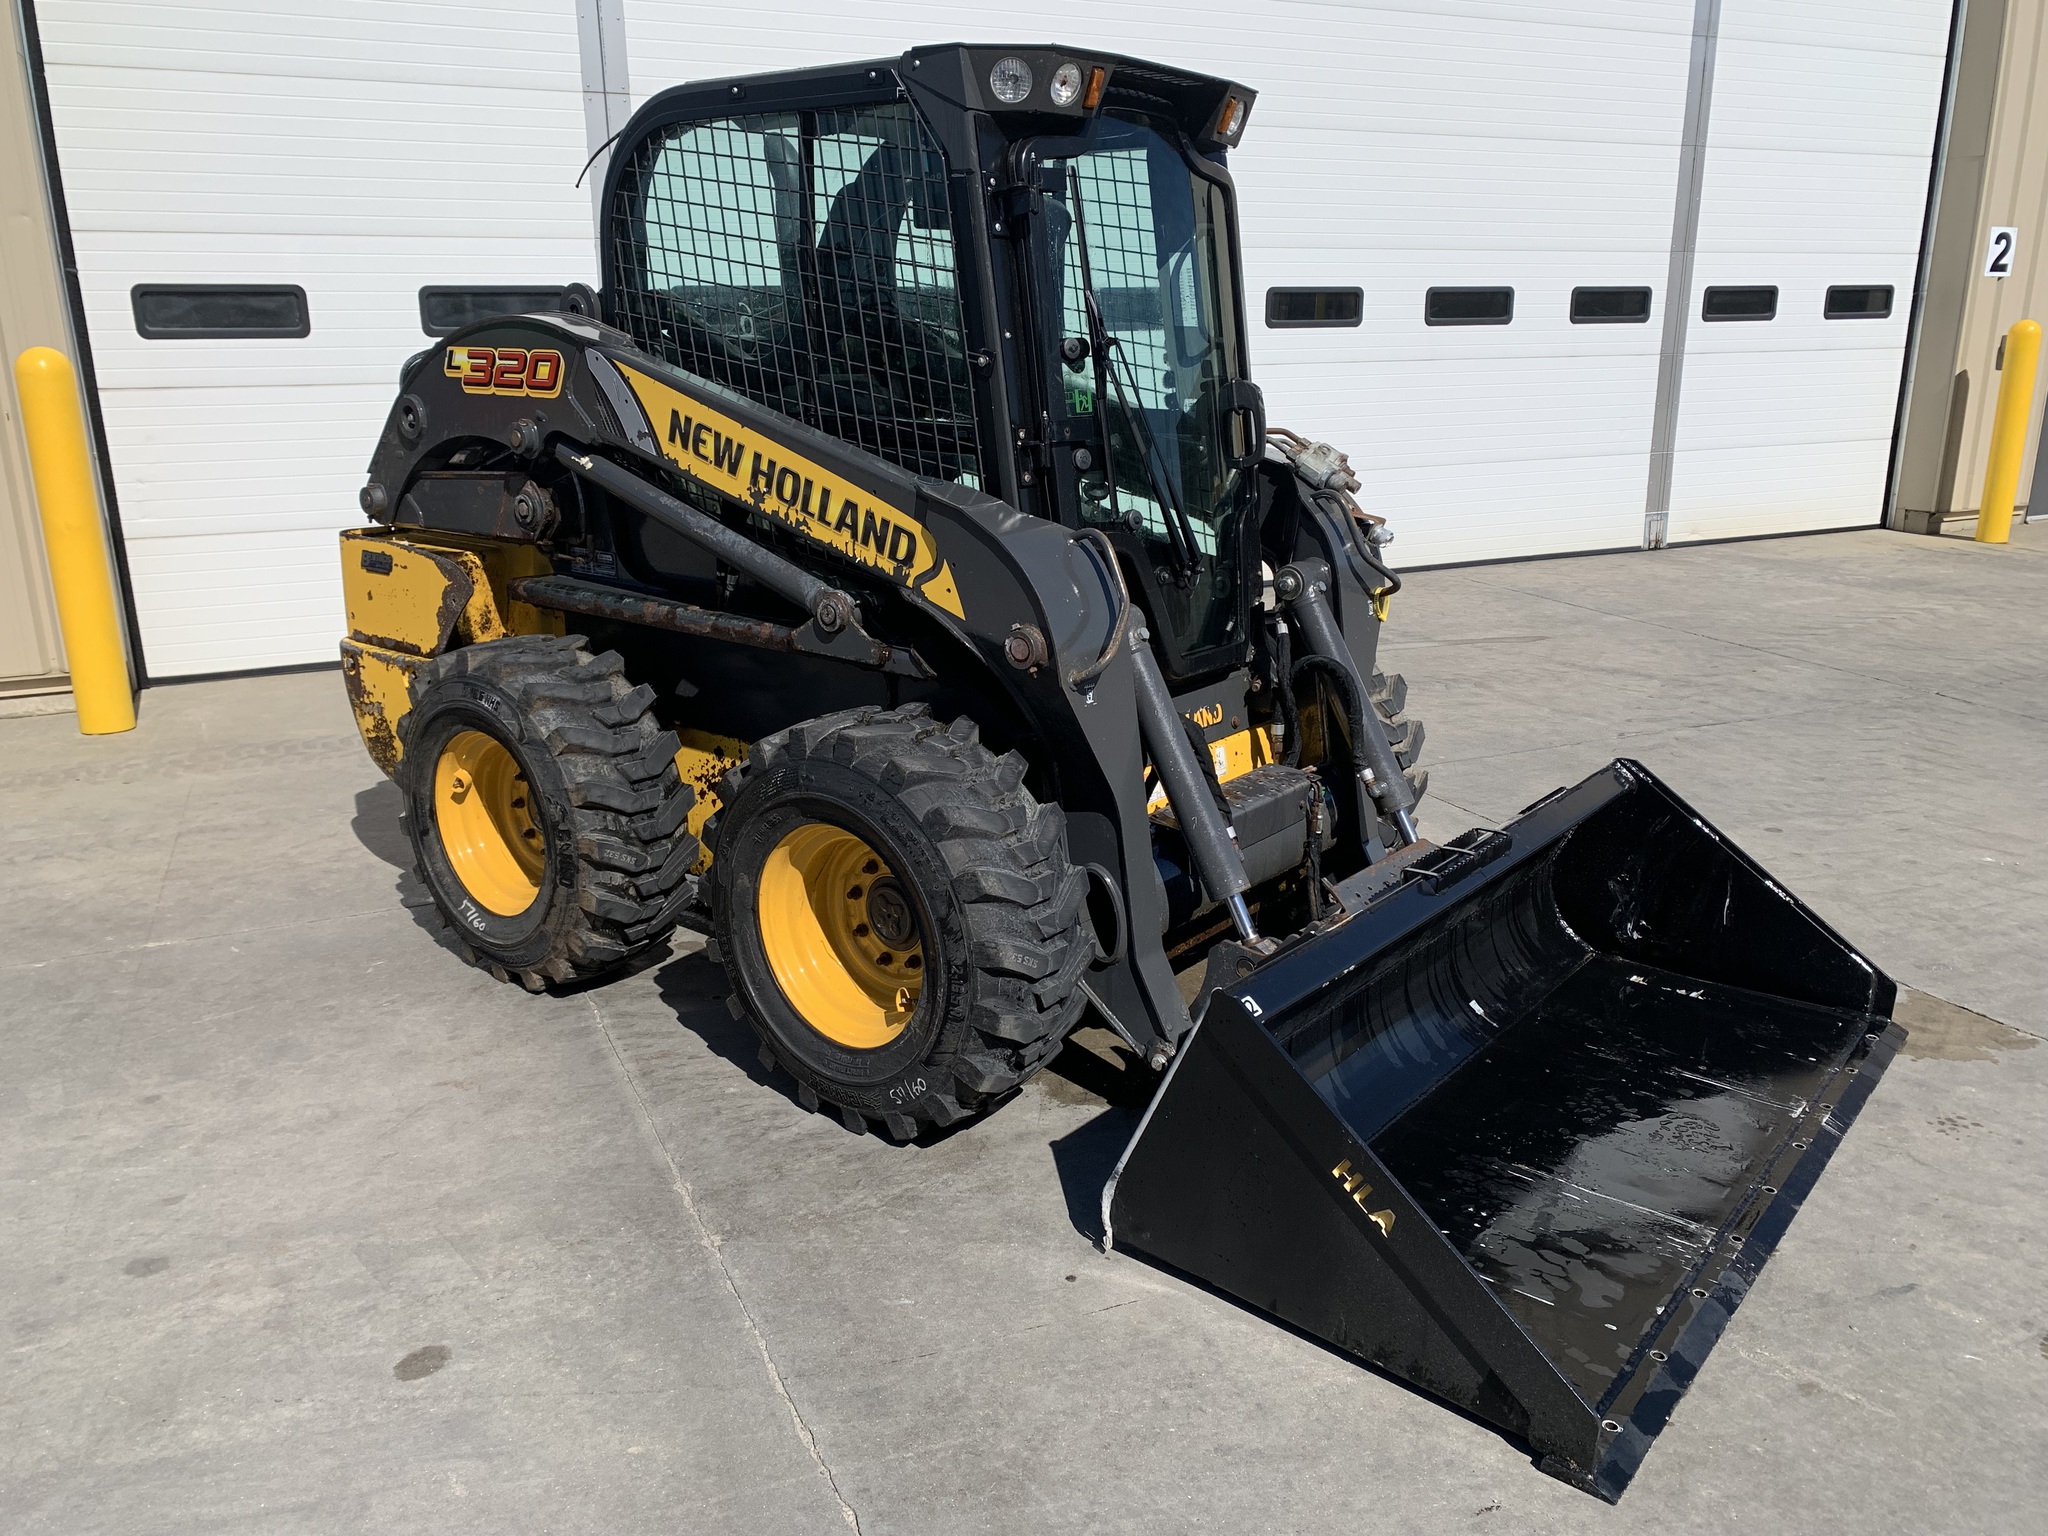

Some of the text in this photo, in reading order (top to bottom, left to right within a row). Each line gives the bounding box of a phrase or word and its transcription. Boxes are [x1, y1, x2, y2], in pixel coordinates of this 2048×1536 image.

[1990, 231, 2012, 273] 2
[445, 347, 563, 394] L320
[667, 407, 918, 568] NEW HOLLAND
[1331, 1157, 1397, 1239] HLA
